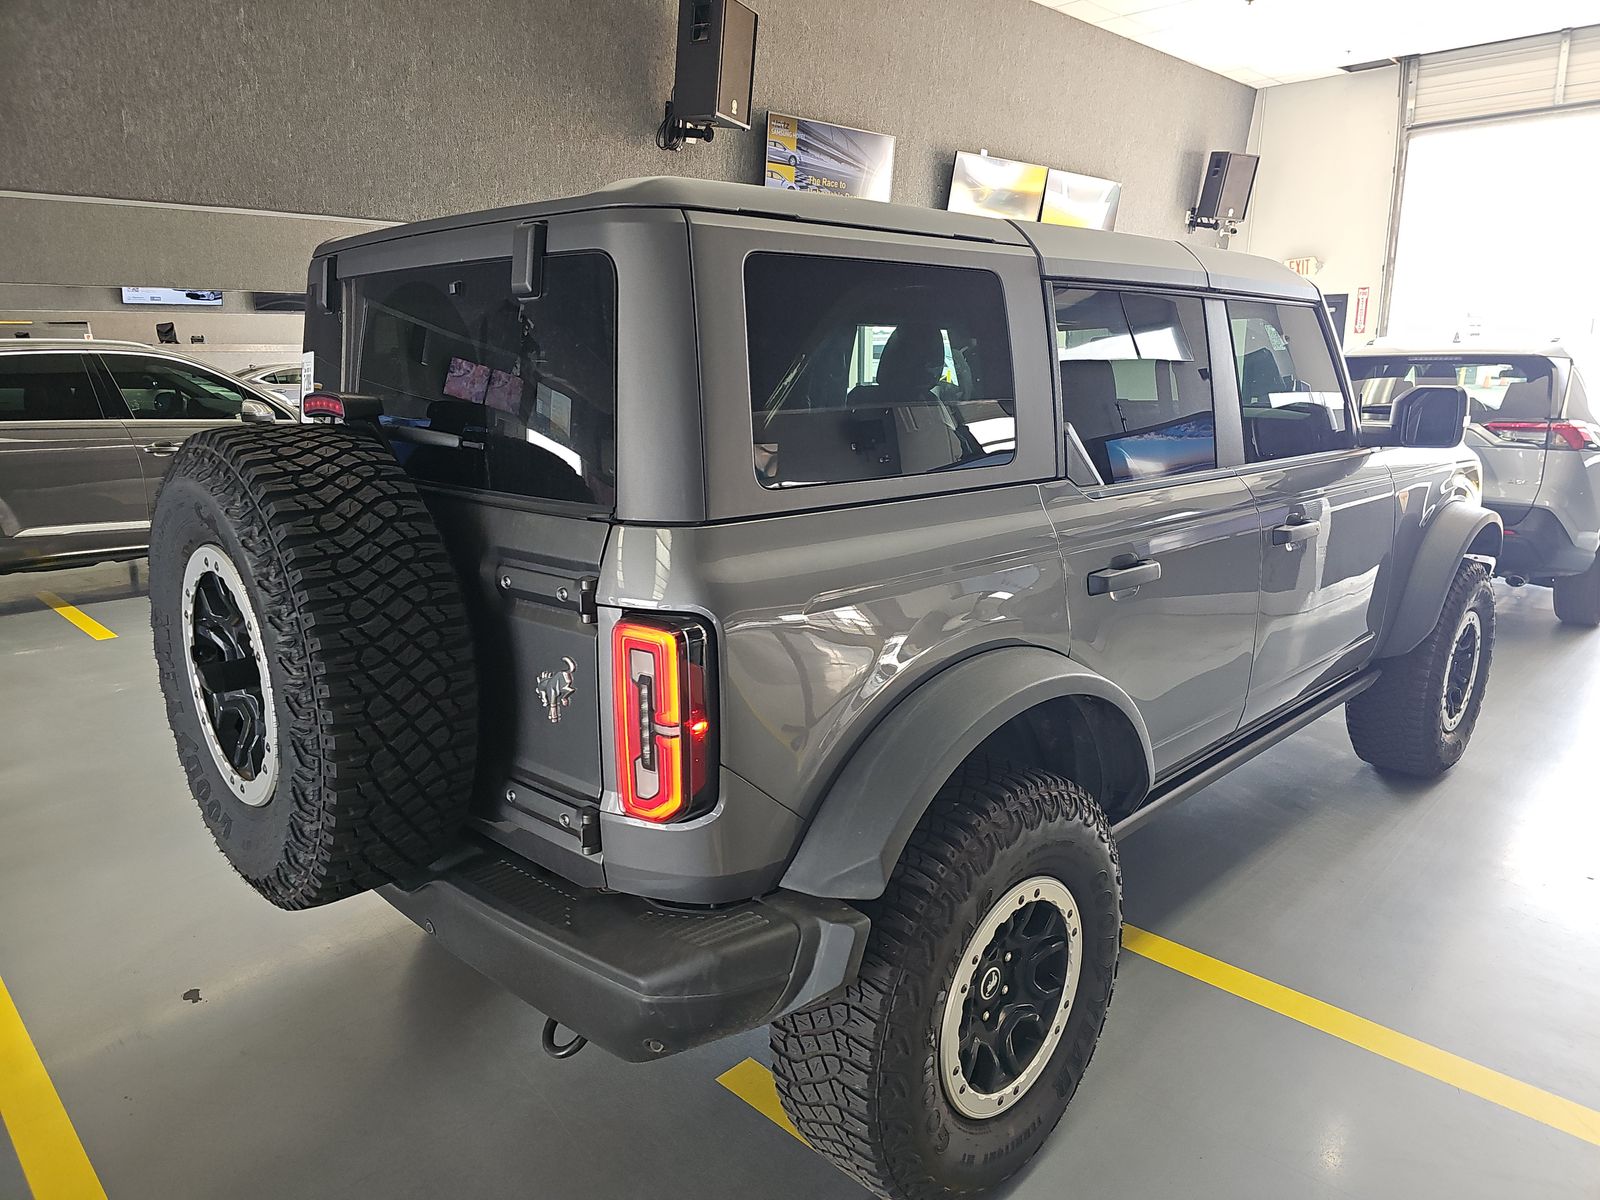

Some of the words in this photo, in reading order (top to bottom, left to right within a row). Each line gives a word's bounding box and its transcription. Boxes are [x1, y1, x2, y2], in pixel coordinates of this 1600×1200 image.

[808, 175, 821, 186] The
[822, 177, 839, 188] Race
[839, 181, 847, 189] to
[1289, 259, 1310, 275] EXIT
